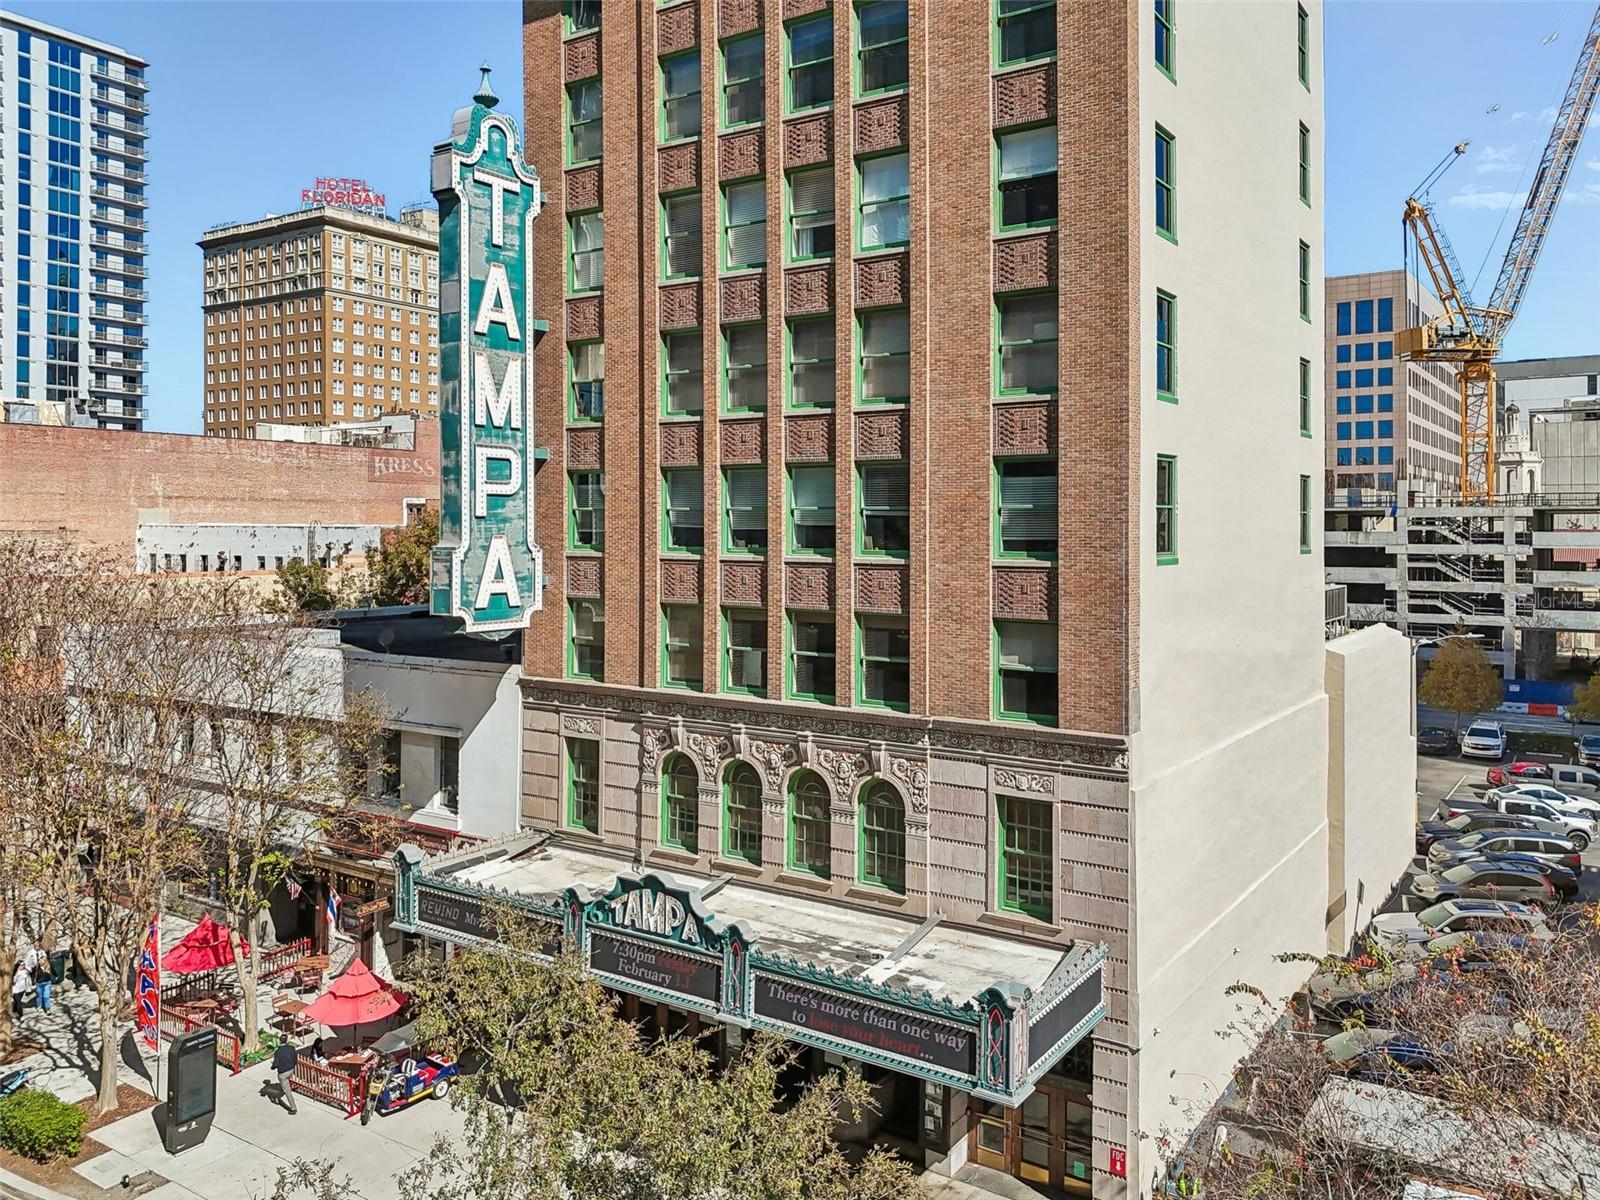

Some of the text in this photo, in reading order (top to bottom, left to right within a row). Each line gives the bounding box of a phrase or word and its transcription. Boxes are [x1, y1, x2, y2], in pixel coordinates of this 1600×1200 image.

[315, 176, 373, 193] HOTEL
[302, 189, 386, 208] FLORIDAN
[472, 166, 521, 611] TAMPA
[374, 455, 436, 478] KRESS
[420, 899, 460, 920] REWIND
[611, 888, 700, 943] TAMPA
[612, 942, 656, 964] 7:30pm
[618, 958, 672, 987] February
[768, 983, 967, 1052] There's more than one way
[792, 1009, 806, 1023] to
